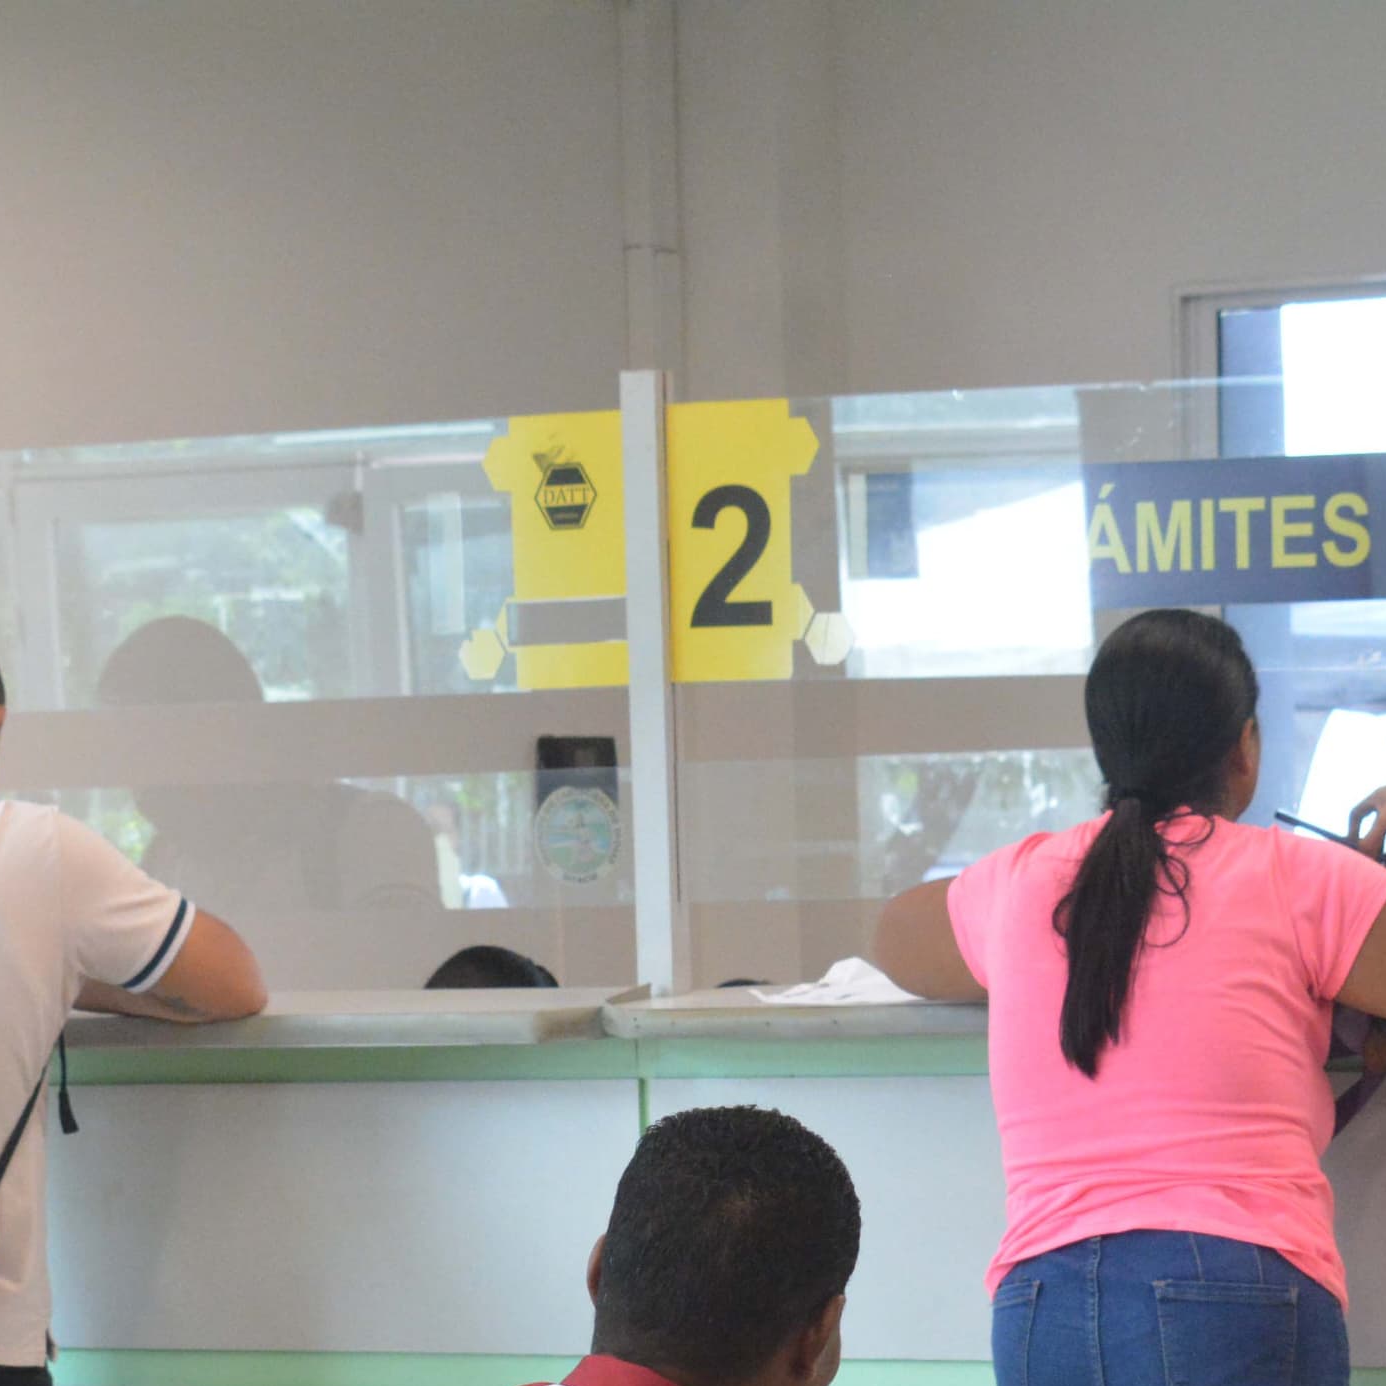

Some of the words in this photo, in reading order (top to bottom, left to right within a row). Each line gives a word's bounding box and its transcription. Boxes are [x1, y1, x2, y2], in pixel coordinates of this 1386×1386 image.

[543, 486, 590, 505] DATT
[1088, 482, 1371, 574] ÁMITES
[692, 485, 771, 627] 2
